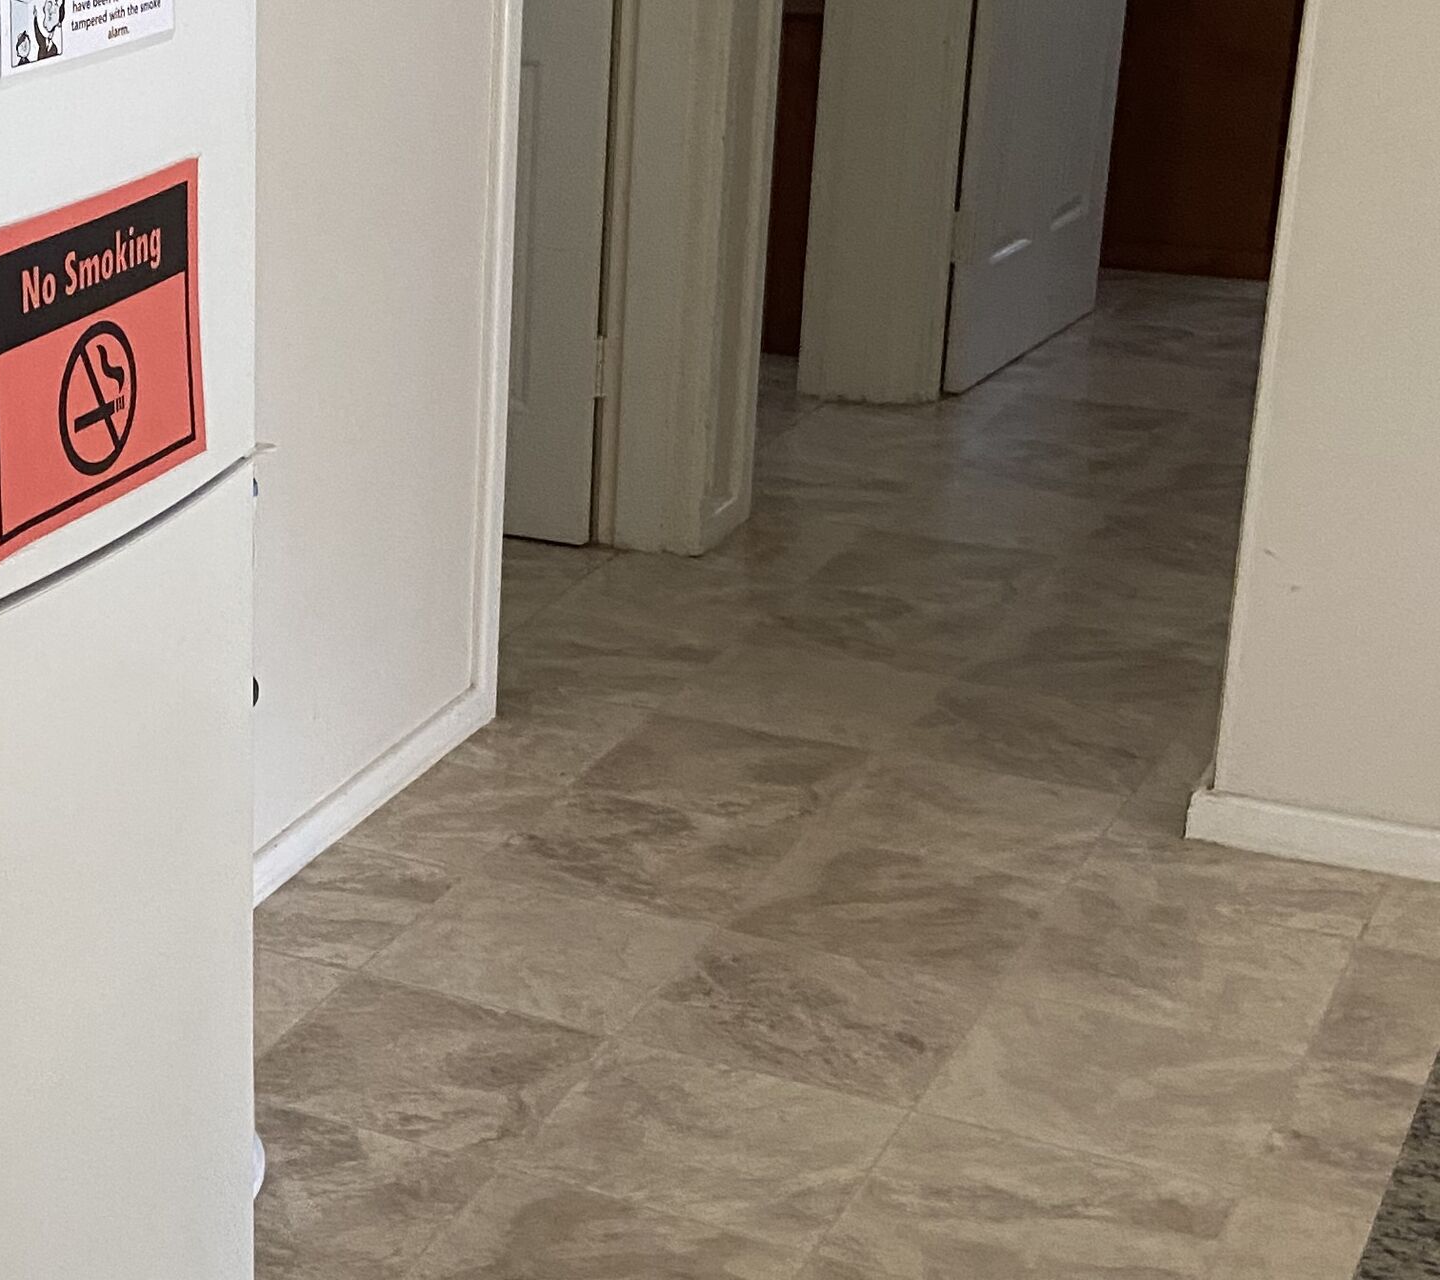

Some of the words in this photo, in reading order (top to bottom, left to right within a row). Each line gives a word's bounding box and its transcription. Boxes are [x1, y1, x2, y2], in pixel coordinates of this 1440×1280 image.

[71, 10, 108, 31] tampered
[109, 6, 126, 21] with
[127, 3, 138, 16] the
[72, 0, 91, 13] have
[108, 25, 130, 40] alarm.
[21, 266, 56, 313] No
[64, 226, 162, 296] Smoking
